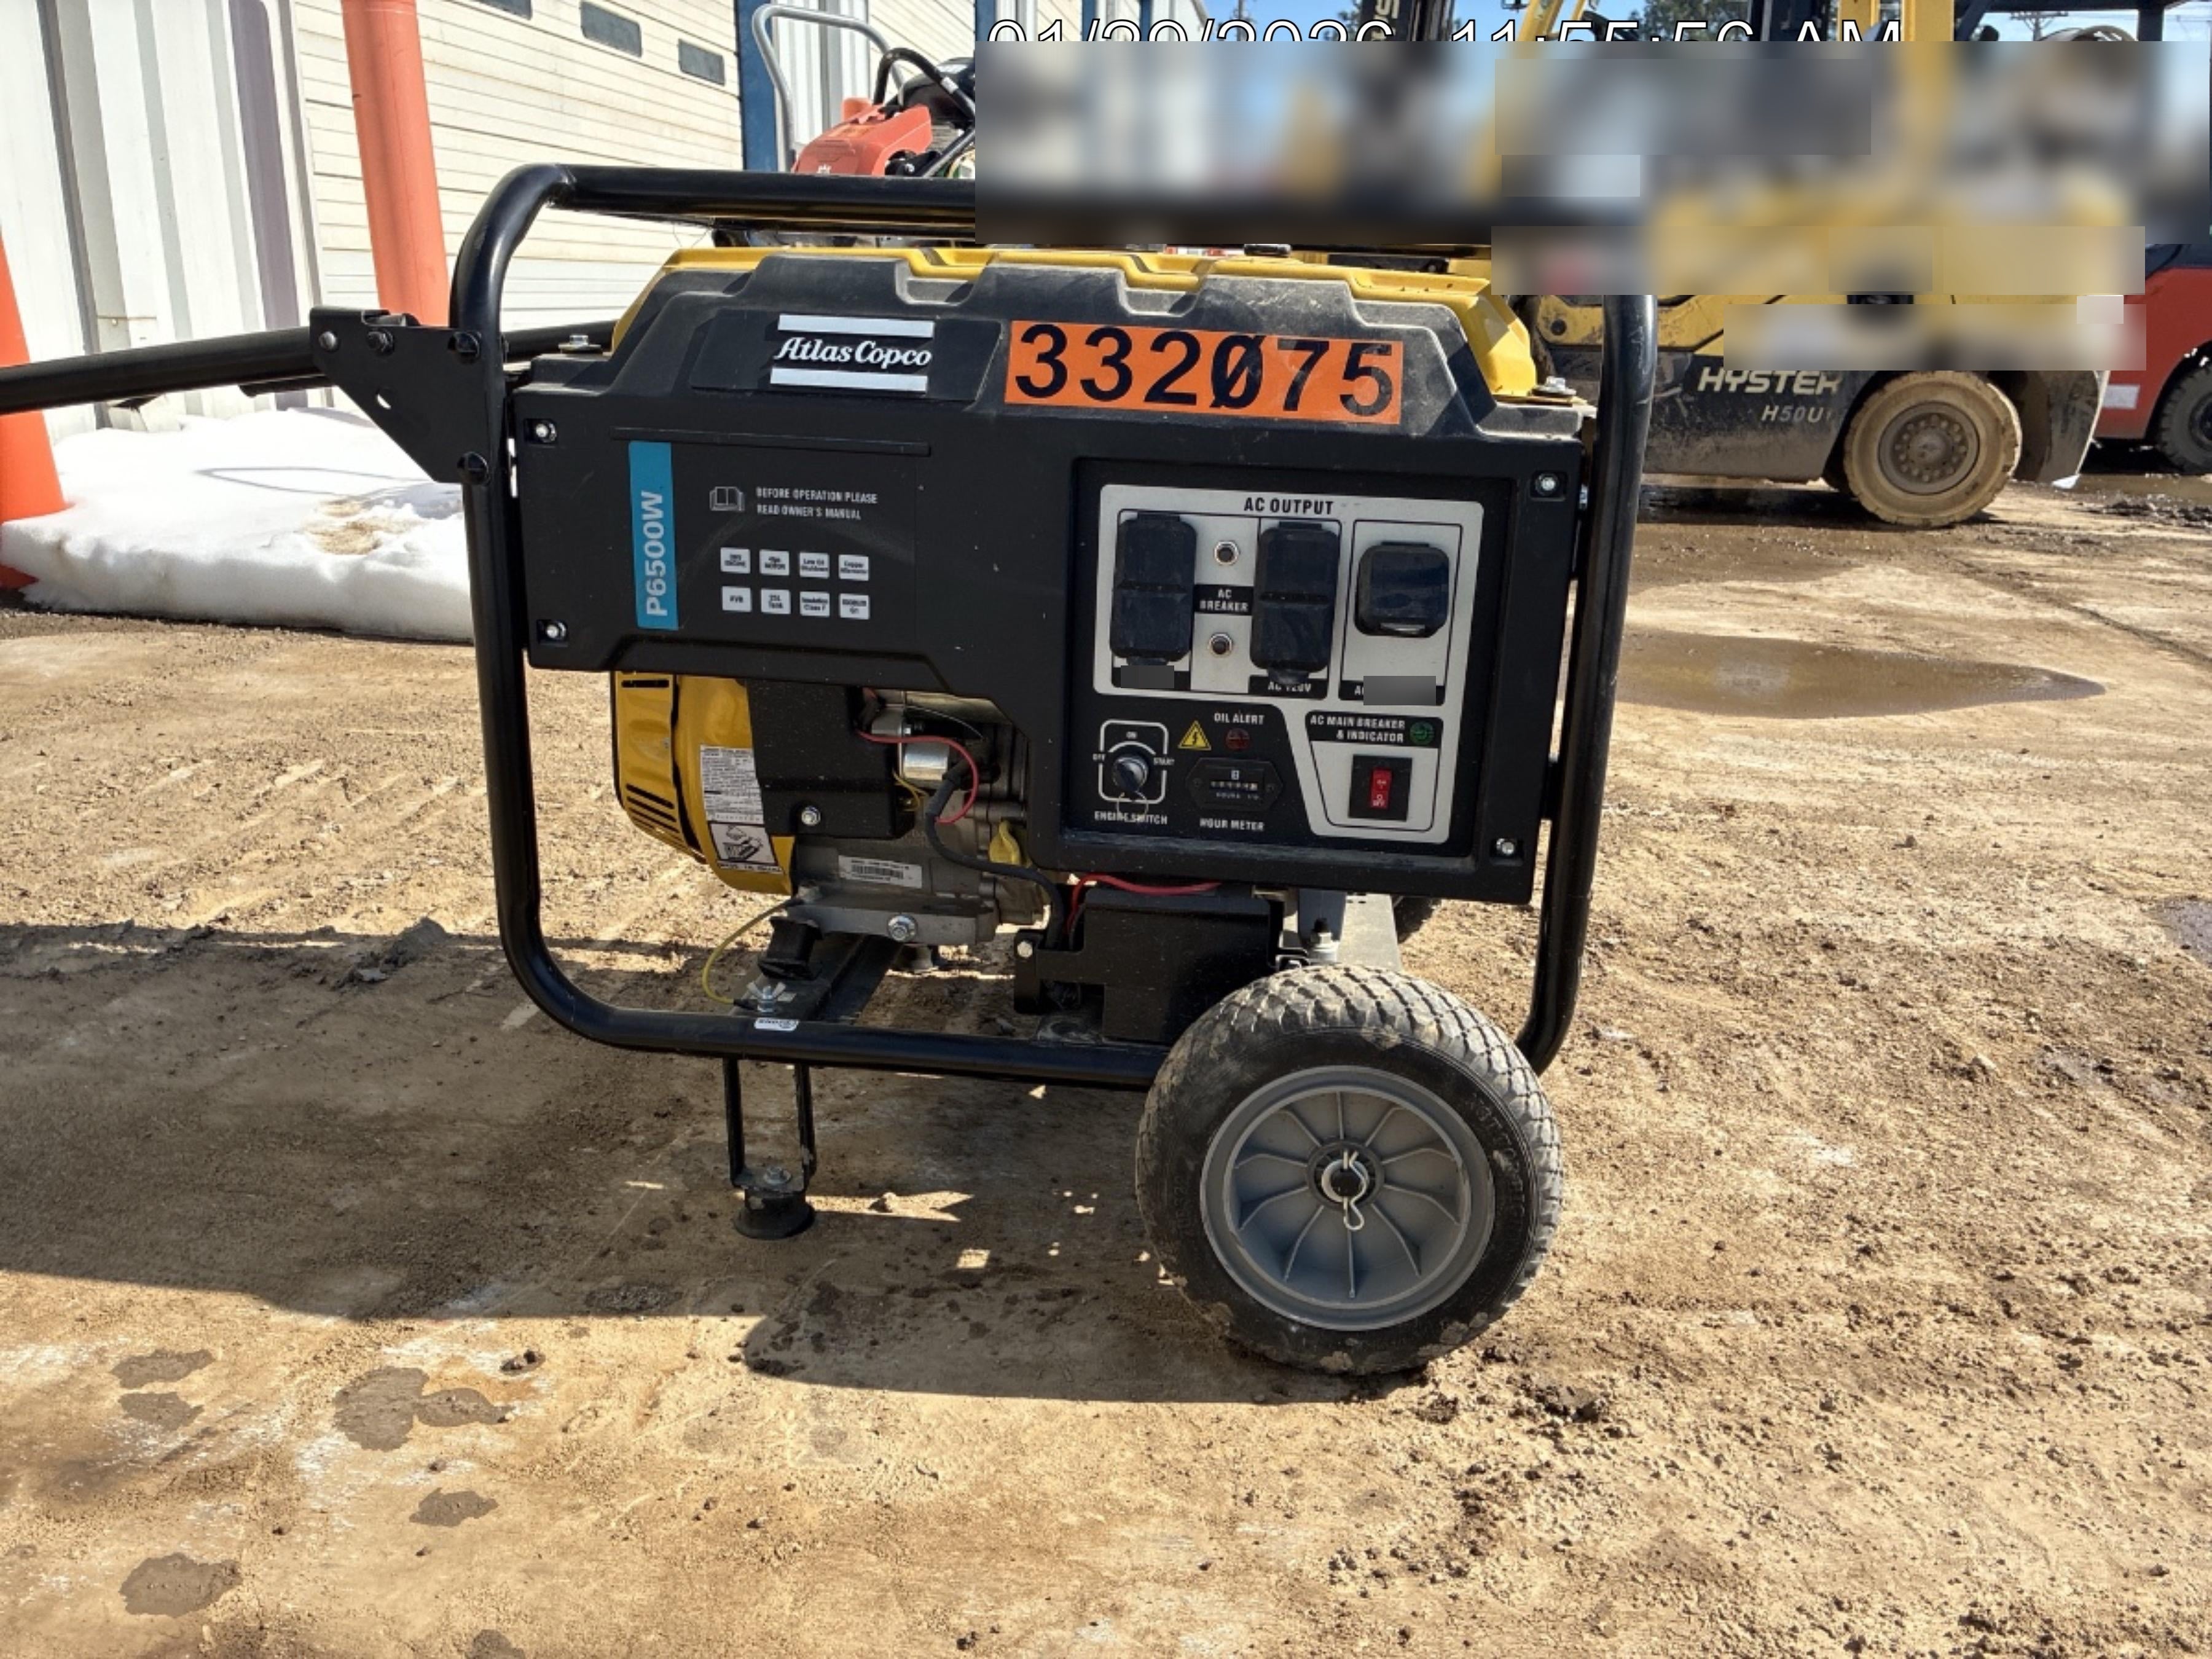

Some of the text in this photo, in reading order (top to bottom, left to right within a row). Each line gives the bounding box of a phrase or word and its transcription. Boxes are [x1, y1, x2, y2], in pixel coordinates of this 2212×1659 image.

[773, 337, 932, 369] Atlas Copco
[756, 486, 877, 504] BEFORE OPERATION PLEASE
[757, 504, 779, 515] READ
[825, 507, 861, 520] MANUAL
[1244, 496, 1334, 515] AC OUTPUT
[641, 490, 668, 616] P6500W
[1218, 588, 1232, 599] AC
[1199, 600, 1249, 612] BREAKER
[1214, 712, 1265, 725] OIL ALERT
[1310, 715, 1405, 730] AC MAIN BREAKER
[1336, 729, 1404, 743] & INDICATOR
[1199, 817, 1265, 831] HOUR METER
